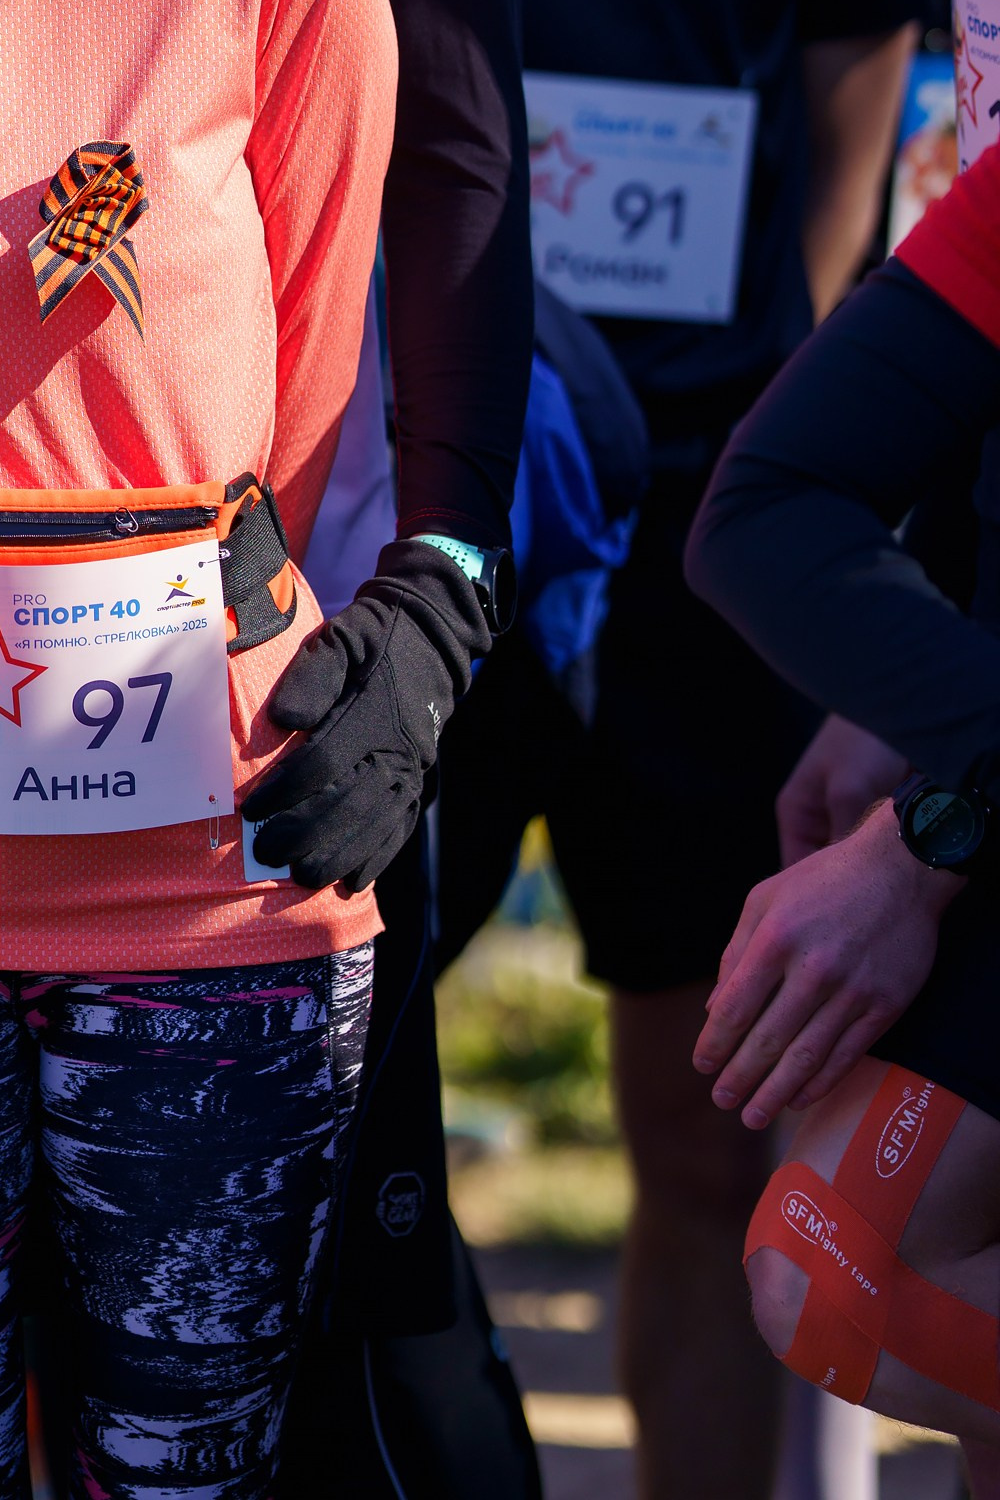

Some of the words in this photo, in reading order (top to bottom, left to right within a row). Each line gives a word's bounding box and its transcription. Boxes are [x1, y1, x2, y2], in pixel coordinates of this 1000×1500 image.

[967, 15, 1000, 41] СПОР
[611, 180, 688, 246] 91
[13, 594, 47, 606] PRO
[13, 603, 105, 626] СПОРТ
[109, 599, 141, 619] 40
[14, 638, 31, 649] «Я
[34, 636, 91, 649] ПОМНЮ.
[94, 624, 180, 645] СТРЕЛКОВКА»
[182, 618, 208, 632] 2025
[71, 671, 174, 750] 97
[12, 766, 137, 801] Анна
[850, 1266, 878, 1296] tape
